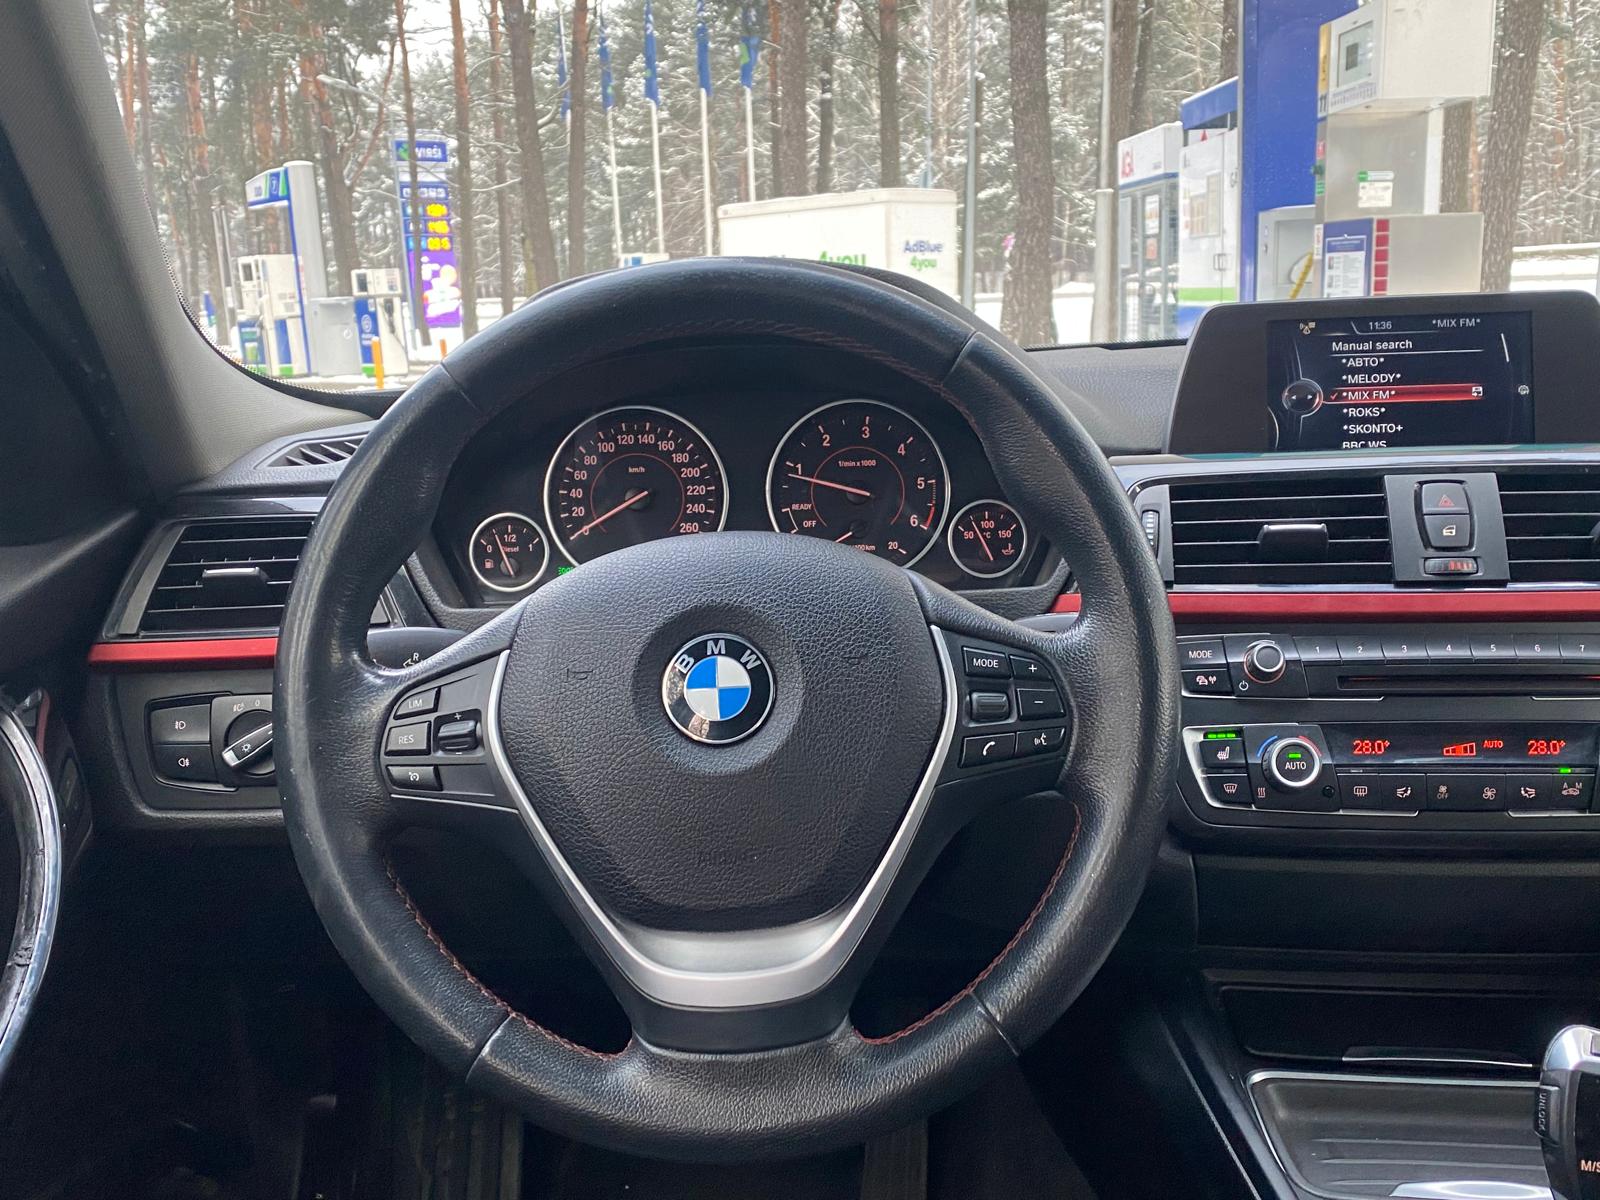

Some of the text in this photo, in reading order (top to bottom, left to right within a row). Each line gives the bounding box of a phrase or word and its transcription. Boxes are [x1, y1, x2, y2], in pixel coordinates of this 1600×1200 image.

[904, 240, 943, 253] AdBlue
[911, 255, 937, 271] 4you
[1368, 321, 1392, 331] 11:36
[1332, 339, 1413, 351] Manual search
[862, 426, 870, 438] 3
[617, 434, 635, 445] 120
[637, 434, 655, 444] 140
[822, 434, 831, 447] 2
[597, 442, 615, 452] 100
[657, 440, 675, 451] 160
[897, 443, 906, 456] 4
[583, 455, 597, 465] 80
[671, 452, 689, 463] 180
[628, 466, 645, 474] km/h
[680, 468, 700, 478] 200
[795, 463, 802, 475] 1
[573, 470, 587, 480] 60
[917, 477, 925, 489] 5
[569, 489, 583, 498] 40
[686, 485, 706, 495] 220
[571, 507, 585, 517] 20
[686, 503, 706, 514] 240
[791, 503, 812, 511] READY
[803, 520, 817, 528] OFF
[910, 515, 918, 526] 6
[980, 521, 995, 529] 100
[680, 523, 699, 533] 260
[504, 534, 517, 543] 1/2
[963, 531, 974, 539] 50
[998, 530, 1012, 538] 150
[486, 544, 493, 553] 0
[528, 543, 533, 552] 1
[888, 542, 898, 550] 20
[1402, 645, 1407, 653] 3
[1446, 644, 1452, 652] 4
[1490, 644, 1496, 652] 5
[1535, 644, 1541, 652] 6
[1579, 644, 1585, 652] 7
[674, 639, 762, 674] BMW
[1189, 650, 1213, 659] MODE
[973, 658, 999, 668] MODE
[408, 699, 423, 708] LIM
[398, 735, 415, 745] RES
[1483, 740, 1504, 749] AUTO
[1285, 761, 1307, 770] AUTO
[1539, 1092, 1547, 1131] UNLOCK
